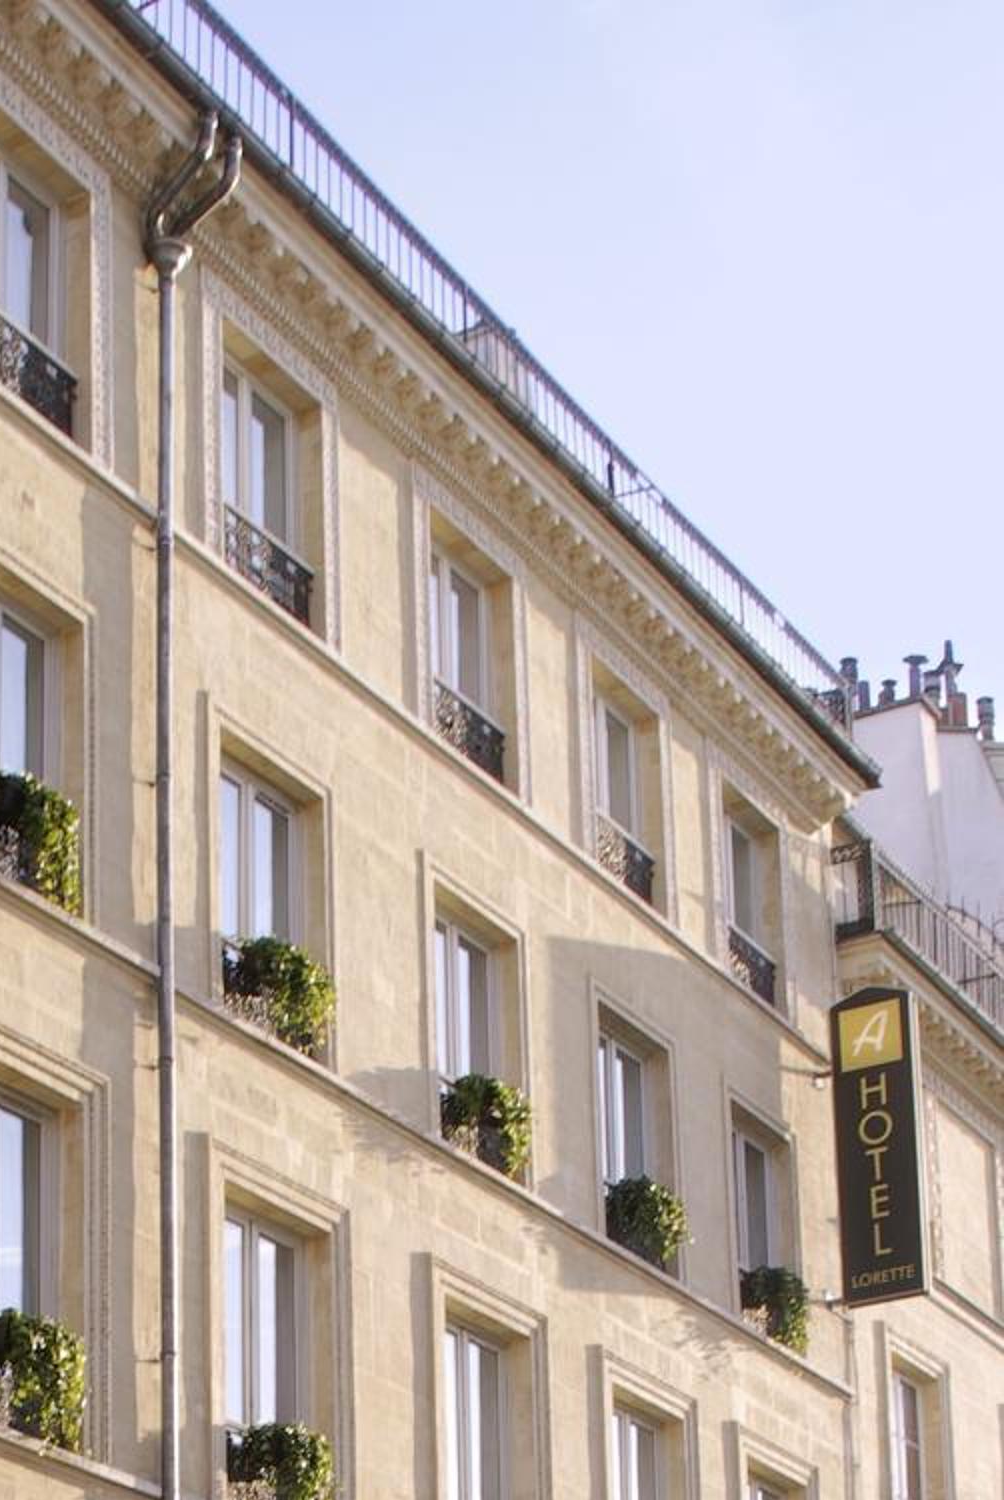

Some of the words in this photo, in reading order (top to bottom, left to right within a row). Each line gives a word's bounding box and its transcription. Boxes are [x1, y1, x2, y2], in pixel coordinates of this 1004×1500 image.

[851, 1009, 890, 1057] A
[857, 1071, 894, 1257] HOTEL
[851, 1264, 917, 1289] LORETTE
